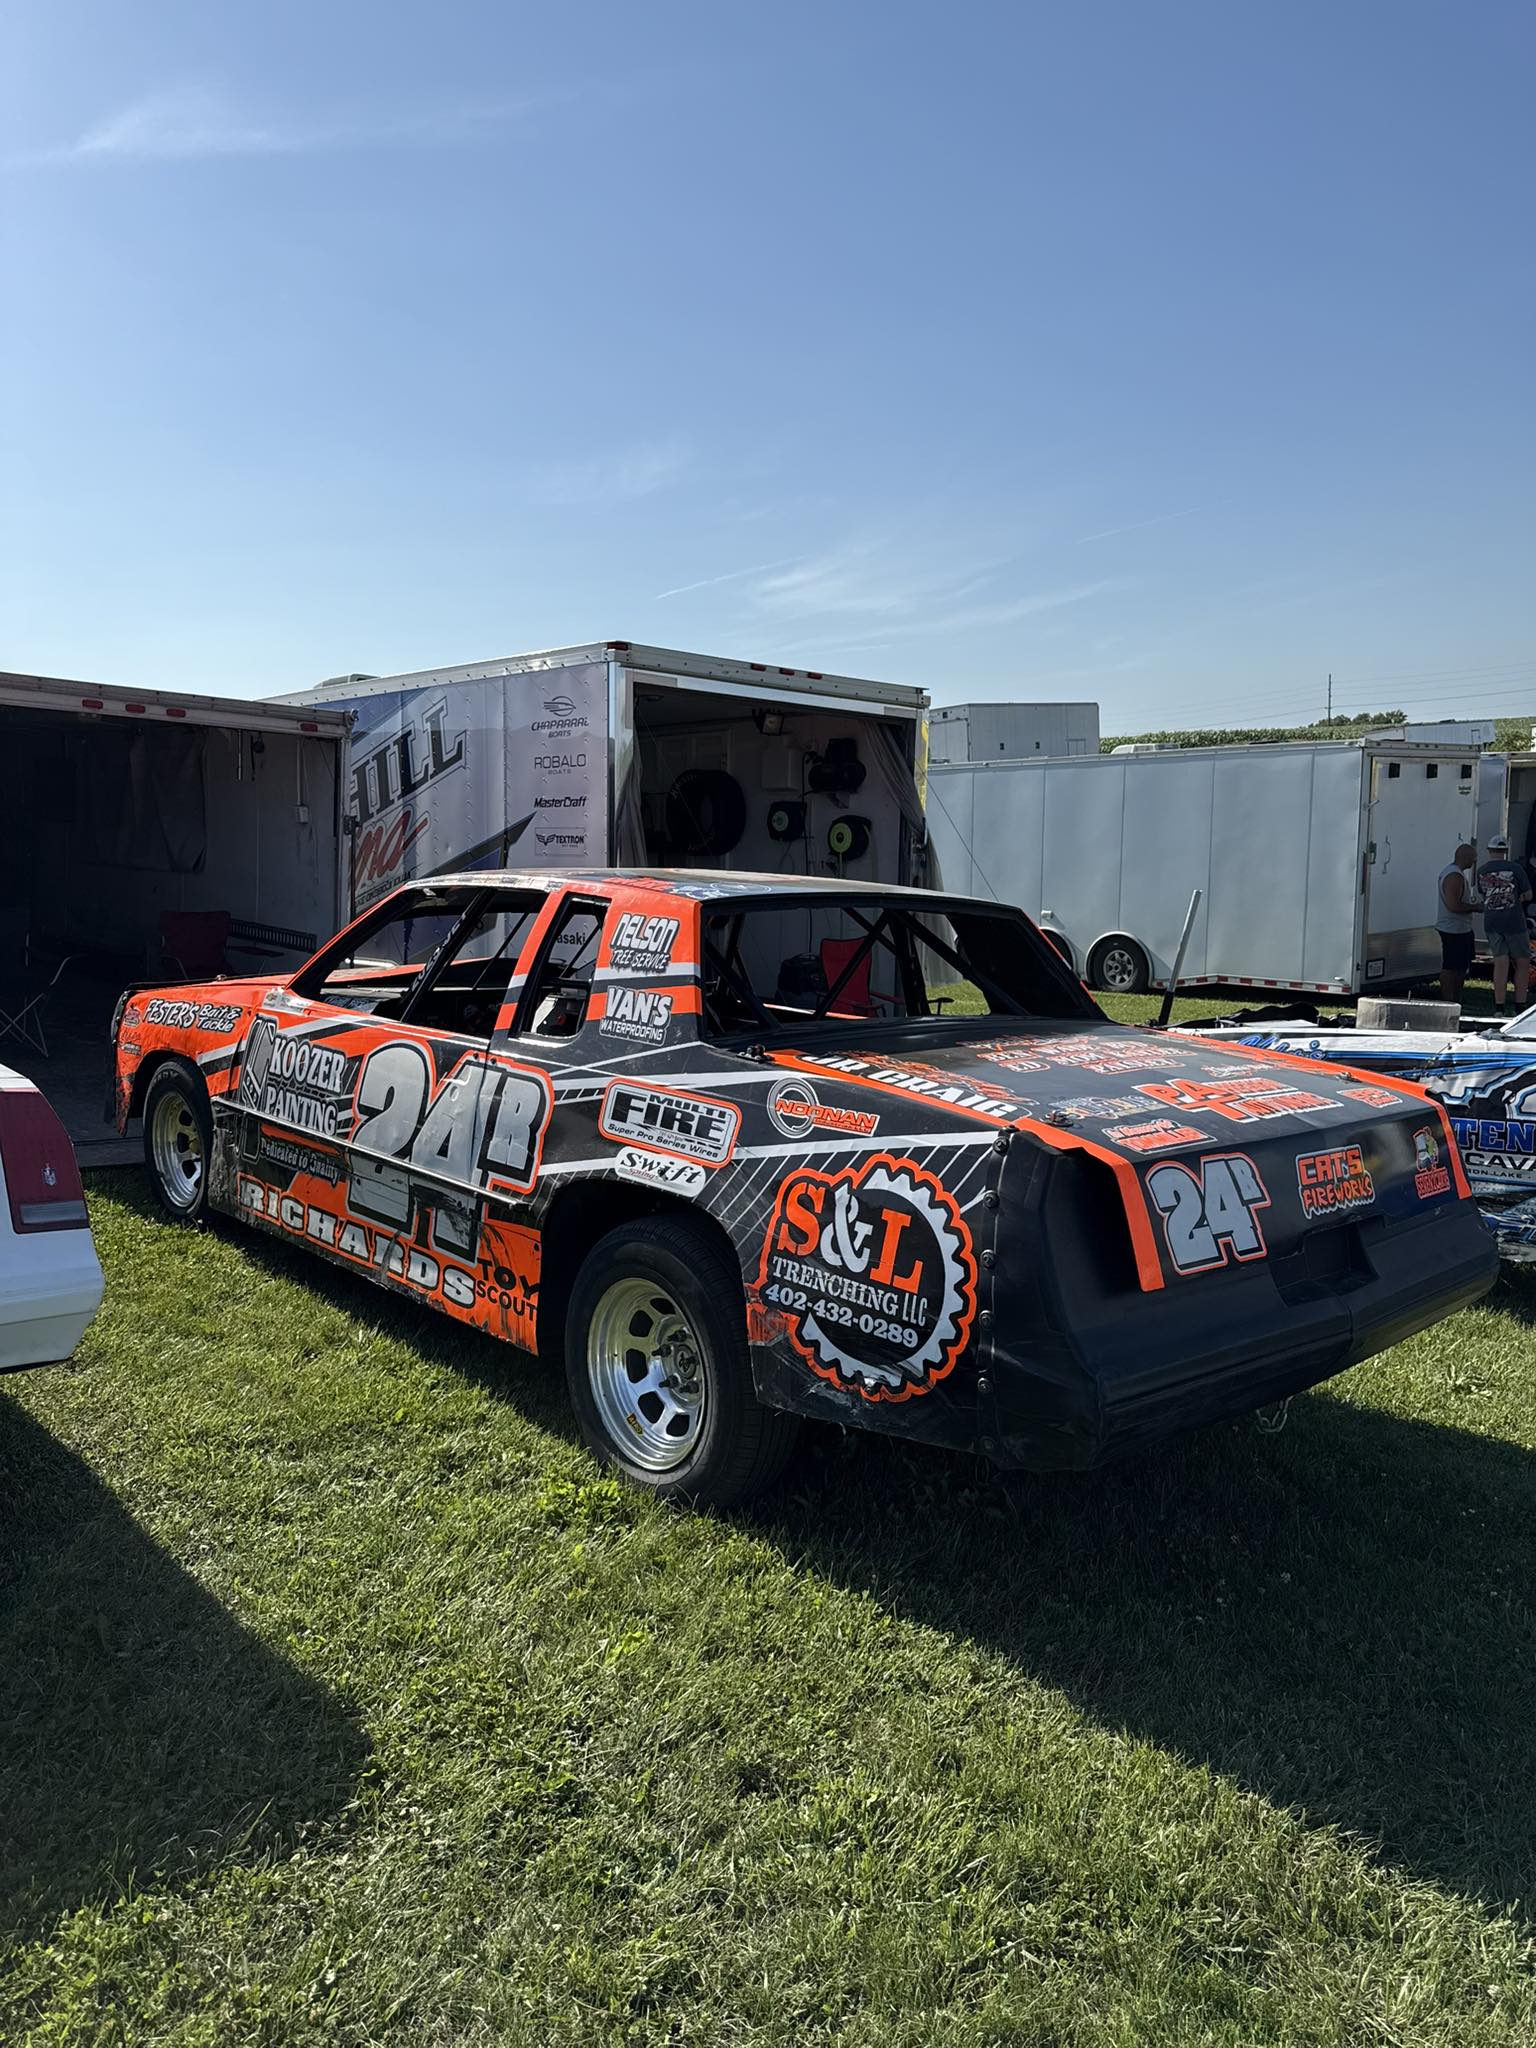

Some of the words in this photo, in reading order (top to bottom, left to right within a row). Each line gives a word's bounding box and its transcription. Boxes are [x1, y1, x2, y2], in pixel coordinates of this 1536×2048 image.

[548, 730, 571, 738] BOATS
[534, 754, 586, 769] ROBALO
[534, 796, 586, 808] MasterCraft
[556, 835, 584, 844] TEXTRON
[611, 913, 679, 953] NELSON
[612, 950, 632, 966] TREE
[631, 952, 669, 970] SERVICE
[146, 999, 200, 1029] FESTER'S
[198, 1017, 234, 1032] Tackle
[200, 1004, 227, 1019] Bait
[227, 1007, 242, 1019] &
[607, 987, 672, 1027] VAN'S
[600, 1020, 663, 1041] WATERPROOFING
[269, 1037, 345, 1093] KOOZER
[264, 1085, 336, 1136] PAINTING
[650, 1093, 727, 1119] MULTI
[867, 1070, 1018, 1118] CRAIG
[611, 1090, 727, 1143] FIRE
[775, 1098, 877, 1128] NOONAN
[608, 1123, 635, 1136] Super
[636, 1131, 653, 1141] Pro
[656, 1136, 686, 1149] Series
[690, 1145, 719, 1158] Wires
[620, 1152, 701, 1184] Swift
[1298, 1148, 1363, 1185] CAT'S
[1303, 1176, 1373, 1210] FIREWORKS
[239, 1179, 475, 1305] RICHARDS
[777, 1182, 924, 1295] S&L
[477, 1257, 541, 1301] TOY
[772, 1255, 899, 1316] TRENCHING
[902, 1292, 928, 1327] LLC
[477, 1279, 537, 1321] SCOUT
[765, 1283, 918, 1348] 402-432-0289
